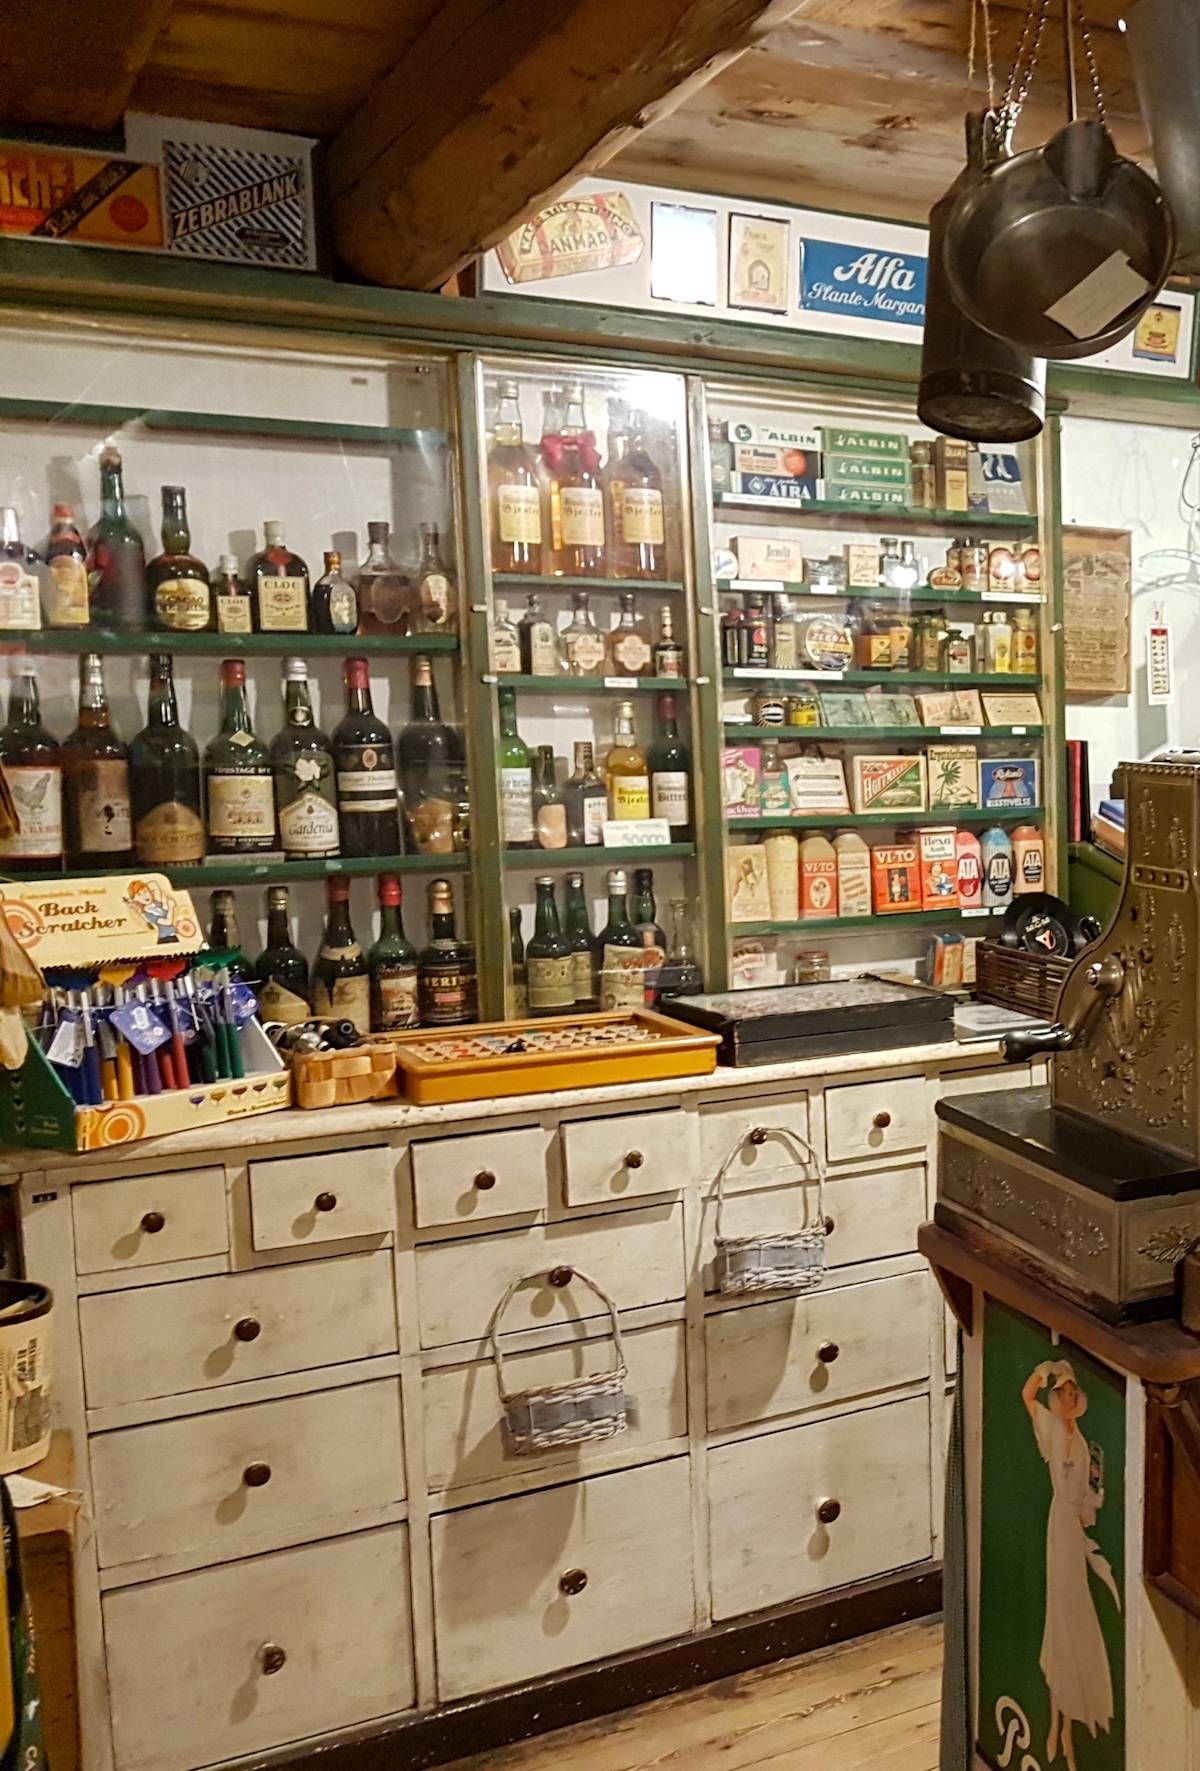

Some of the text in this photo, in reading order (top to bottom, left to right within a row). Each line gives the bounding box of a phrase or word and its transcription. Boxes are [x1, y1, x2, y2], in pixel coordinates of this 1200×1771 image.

[174, 172, 300, 237] ZEBRABLANK
[833, 253, 916, 291] Alfa
[768, 431, 816, 444] ALBIN
[846, 434, 899, 449] ALBIN
[850, 465, 903, 476] ALBIN
[850, 491, 903, 502] ALBIN
[289, 819, 334, 835] Gardenia
[958, 859, 979, 880] ATA
[989, 859, 1011, 880] ATA
[38, 901, 98, 918] Back
[19, 915, 128, 939] Scratcher
